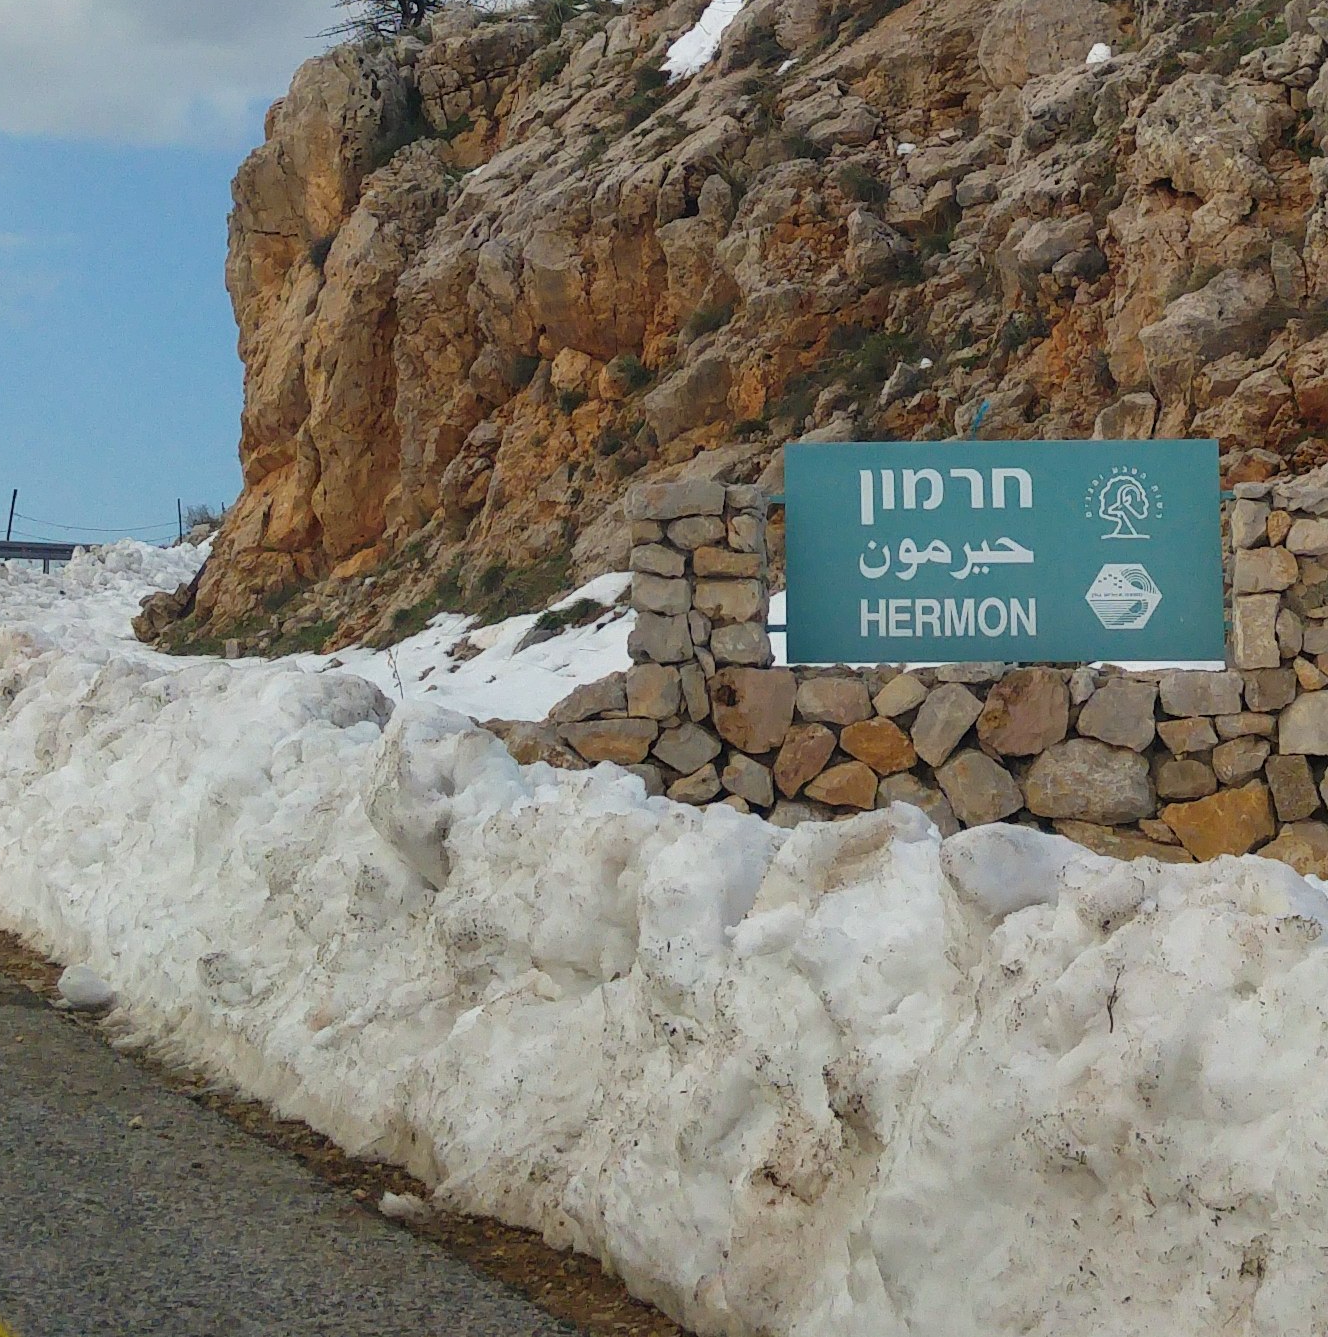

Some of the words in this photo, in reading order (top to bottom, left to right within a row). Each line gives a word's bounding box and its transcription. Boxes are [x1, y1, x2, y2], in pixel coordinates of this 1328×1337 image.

[859, 467, 1033, 525] חרמון
[859, 536, 1034, 580] حيرمون
[859, 597, 1037, 637] HERMON
